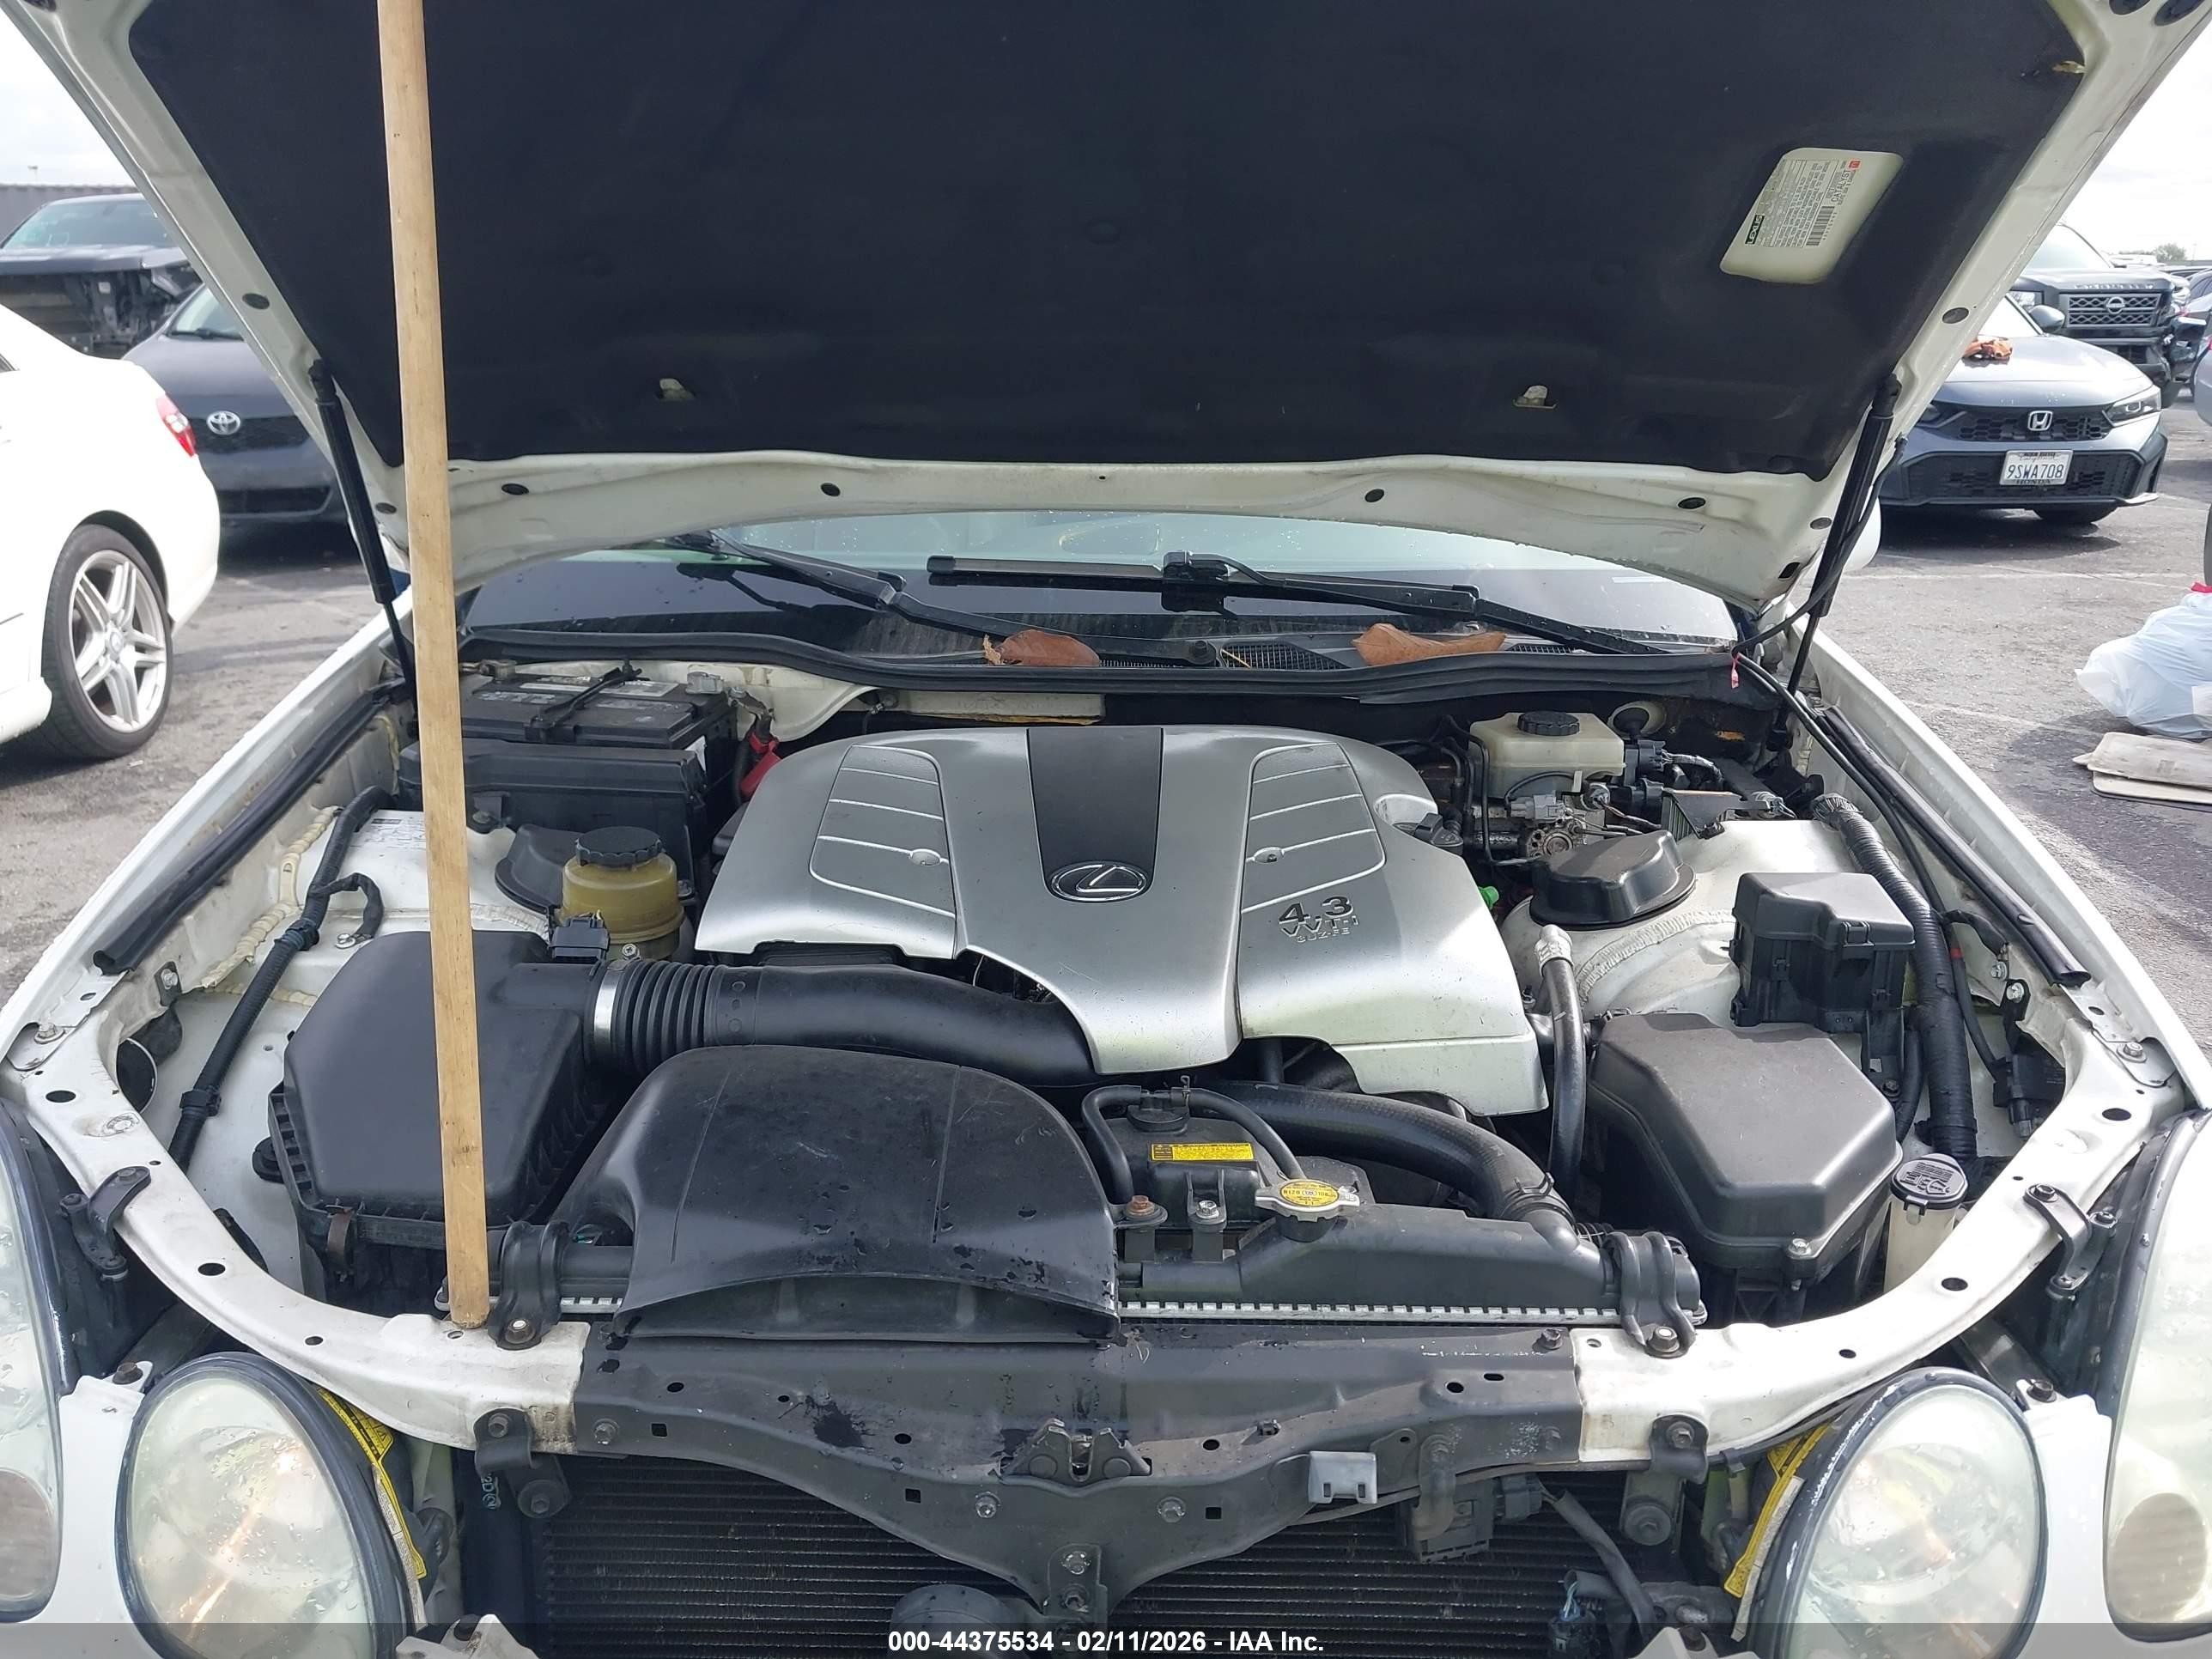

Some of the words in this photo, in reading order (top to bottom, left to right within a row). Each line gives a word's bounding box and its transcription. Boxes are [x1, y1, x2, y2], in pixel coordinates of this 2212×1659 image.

[1831, 170, 1850, 203] CATALYST
[1746, 215, 1765, 244] LEXUS
[2007, 464, 2064, 478] 9SWA708
[1279, 895, 1353, 925] 4.3
